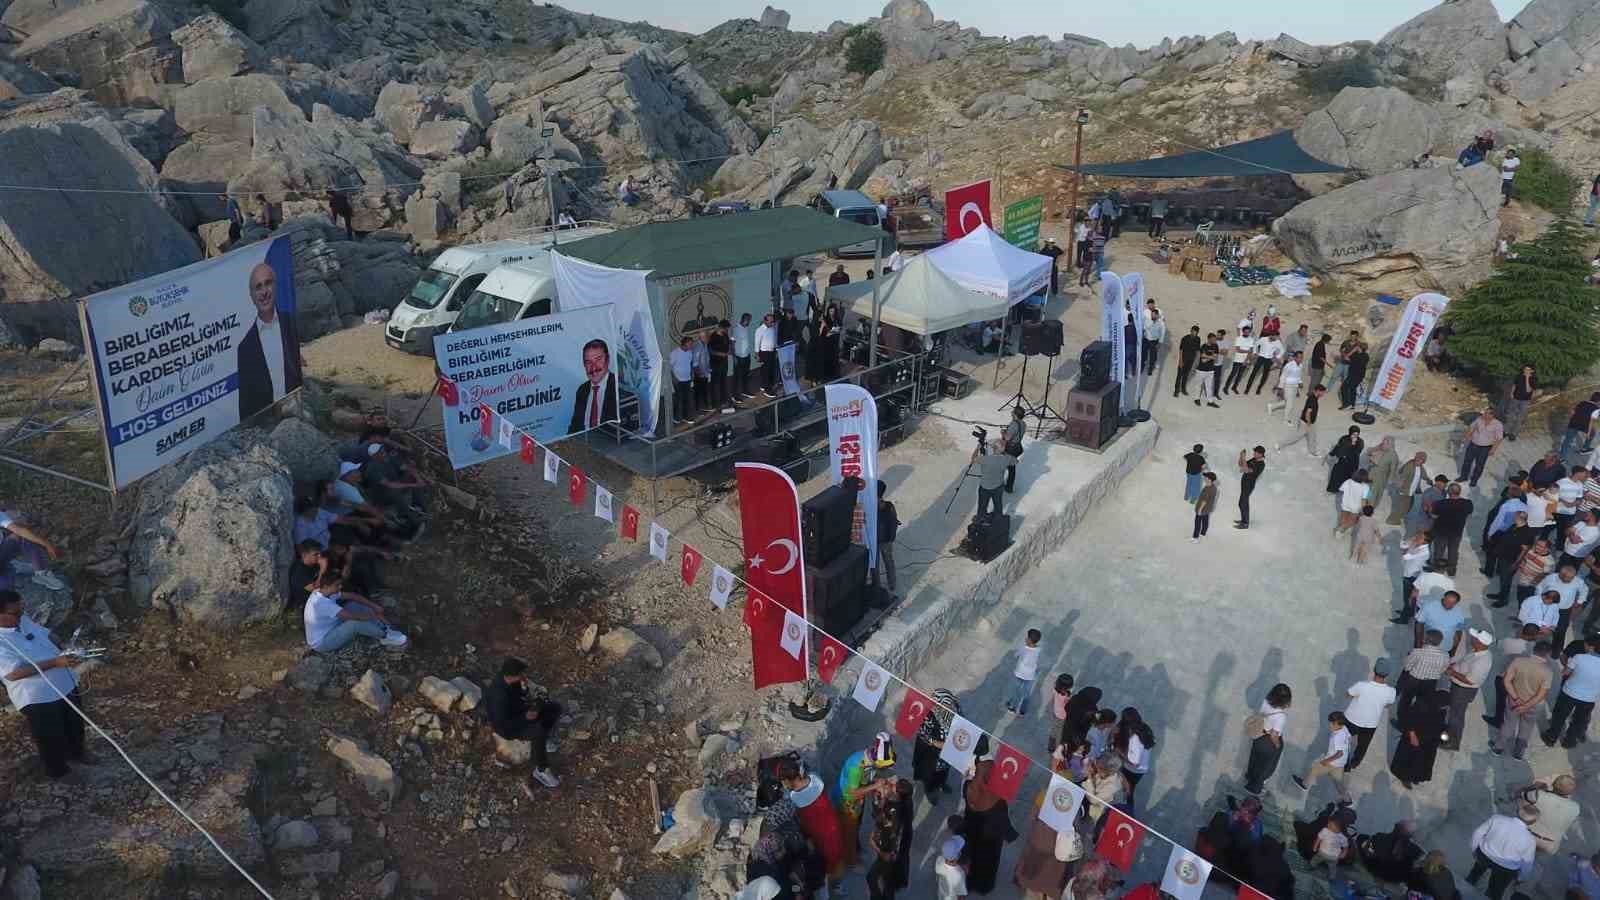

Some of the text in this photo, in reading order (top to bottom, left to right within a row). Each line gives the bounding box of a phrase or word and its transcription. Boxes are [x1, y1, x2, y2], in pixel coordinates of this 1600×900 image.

[161, 380, 229, 419] GELDİNİZ
[496, 385, 562, 415] GELDİNİZ
[190, 416, 206, 434] ER
